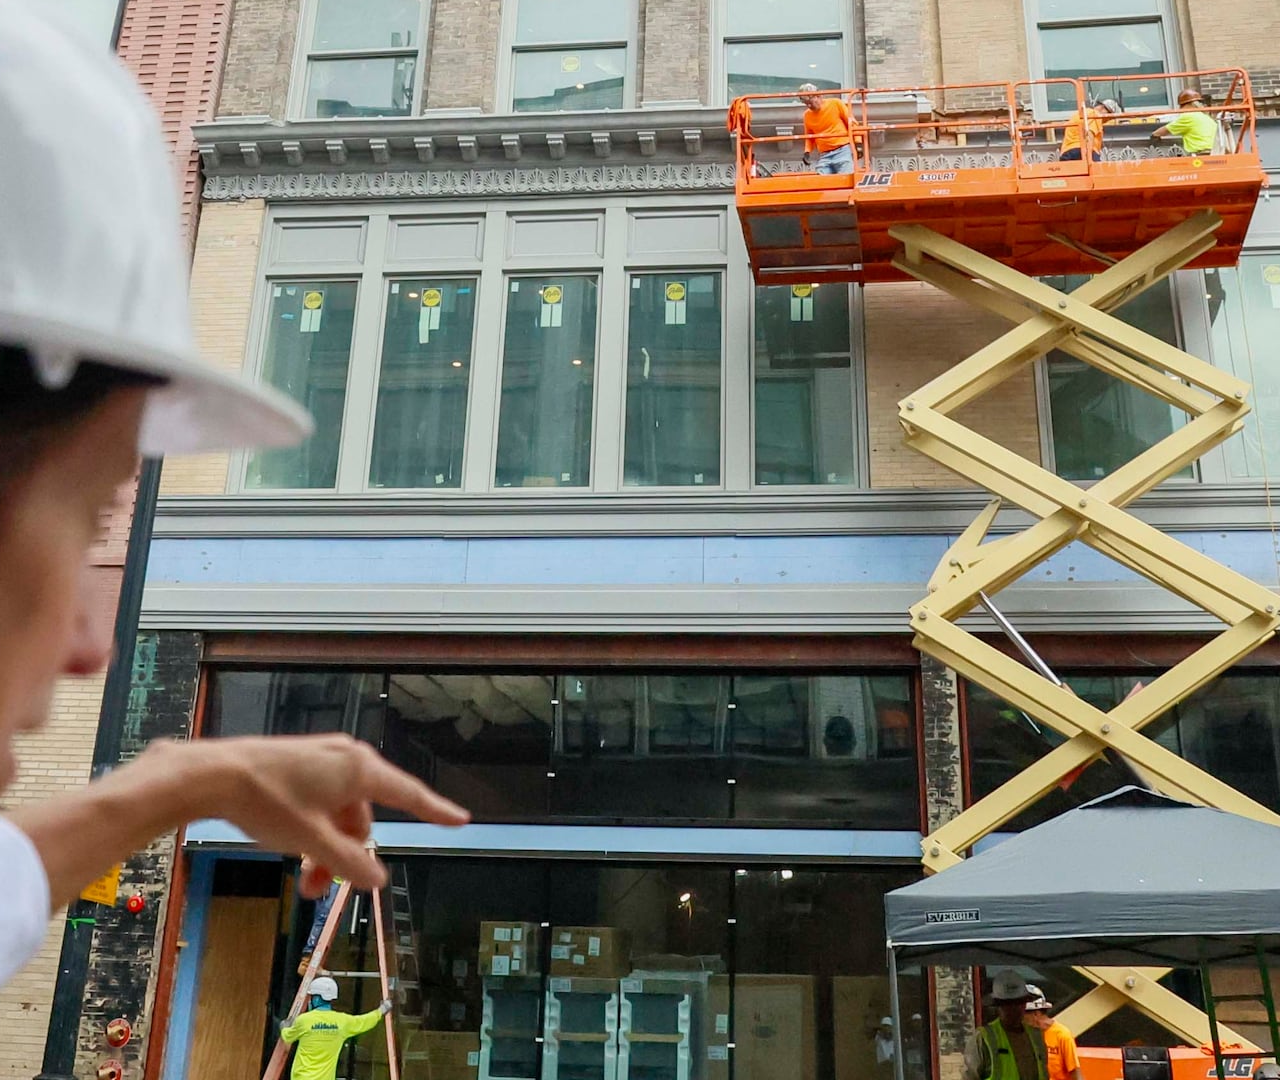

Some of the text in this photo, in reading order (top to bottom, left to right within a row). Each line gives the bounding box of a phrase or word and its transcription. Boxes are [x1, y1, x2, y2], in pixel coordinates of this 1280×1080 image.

[857, 173, 892, 187] JLG
[918, 172, 956, 182] 430LRT
[927, 911, 978, 922] EVERBILT
